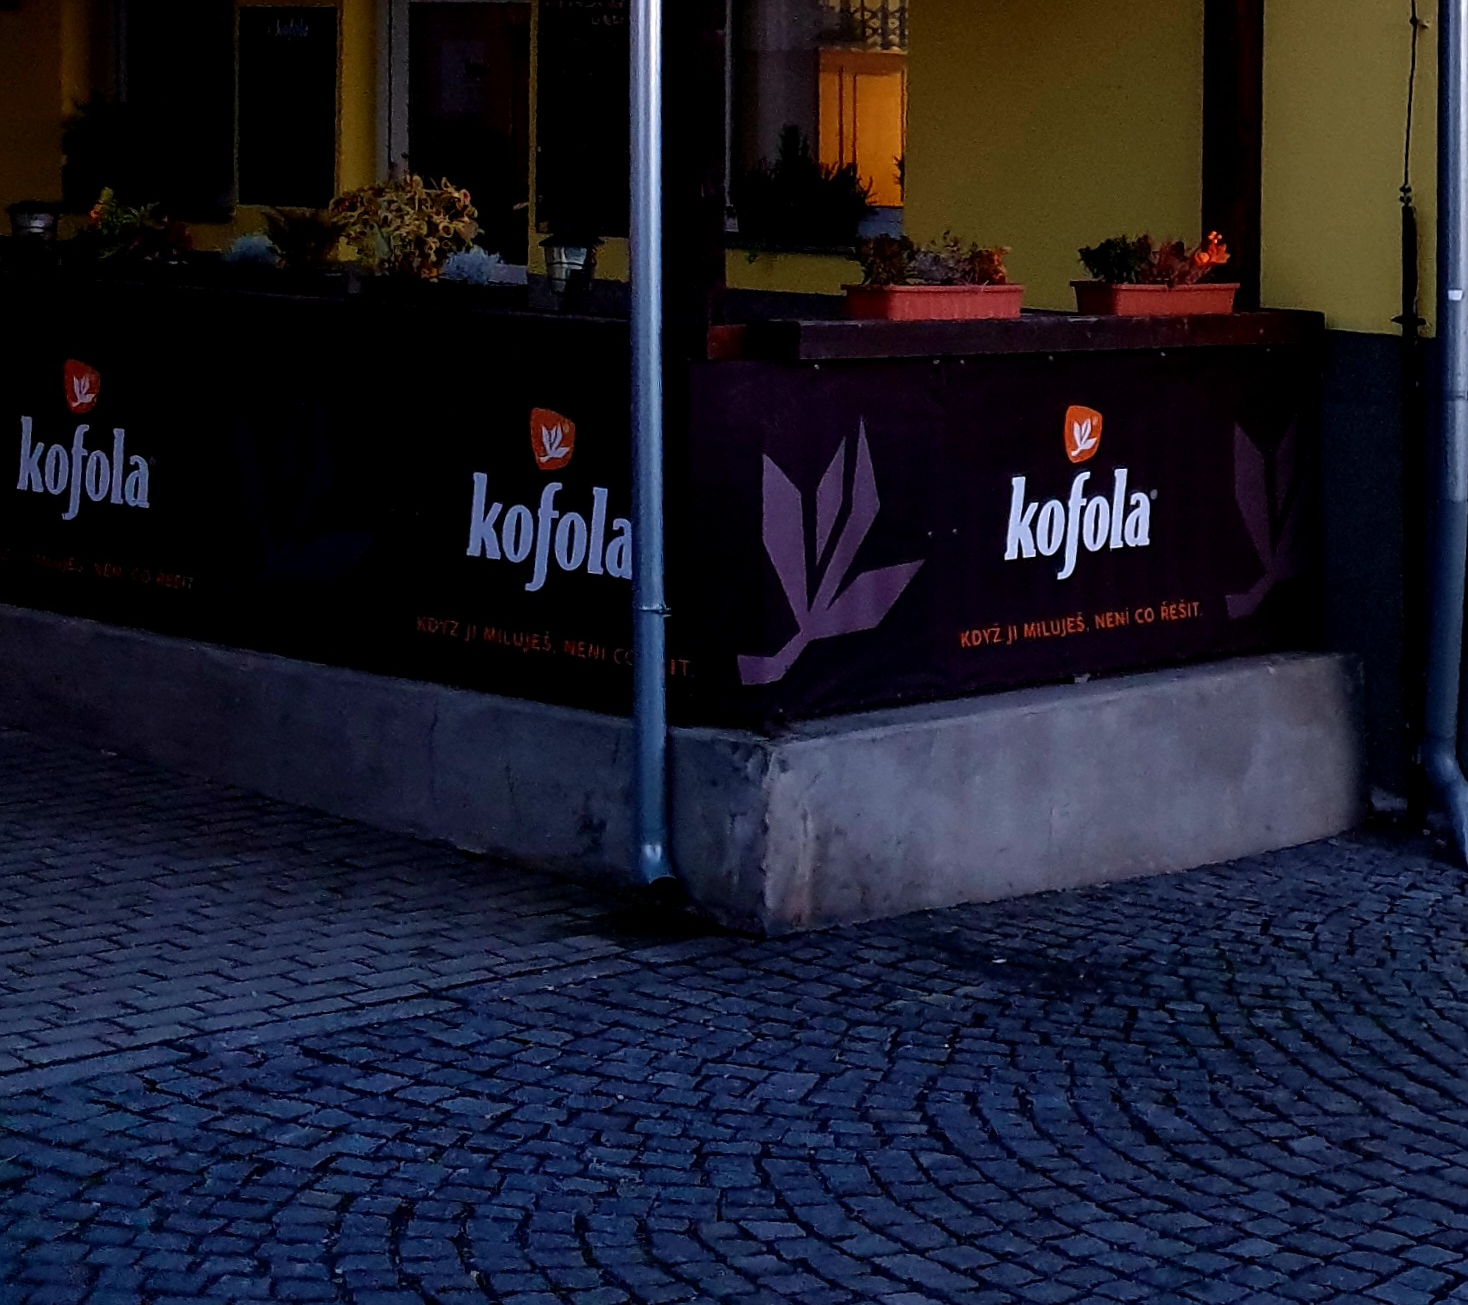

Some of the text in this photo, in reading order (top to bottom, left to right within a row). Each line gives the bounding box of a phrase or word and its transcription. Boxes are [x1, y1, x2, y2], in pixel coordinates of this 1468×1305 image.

[17, 415, 150, 520] kofola
[466, 471, 633, 592] kofola
[1004, 468, 1151, 580] kofola
[1006, 624, 1018, 645] JI
[1134, 606, 1155, 625] CO
